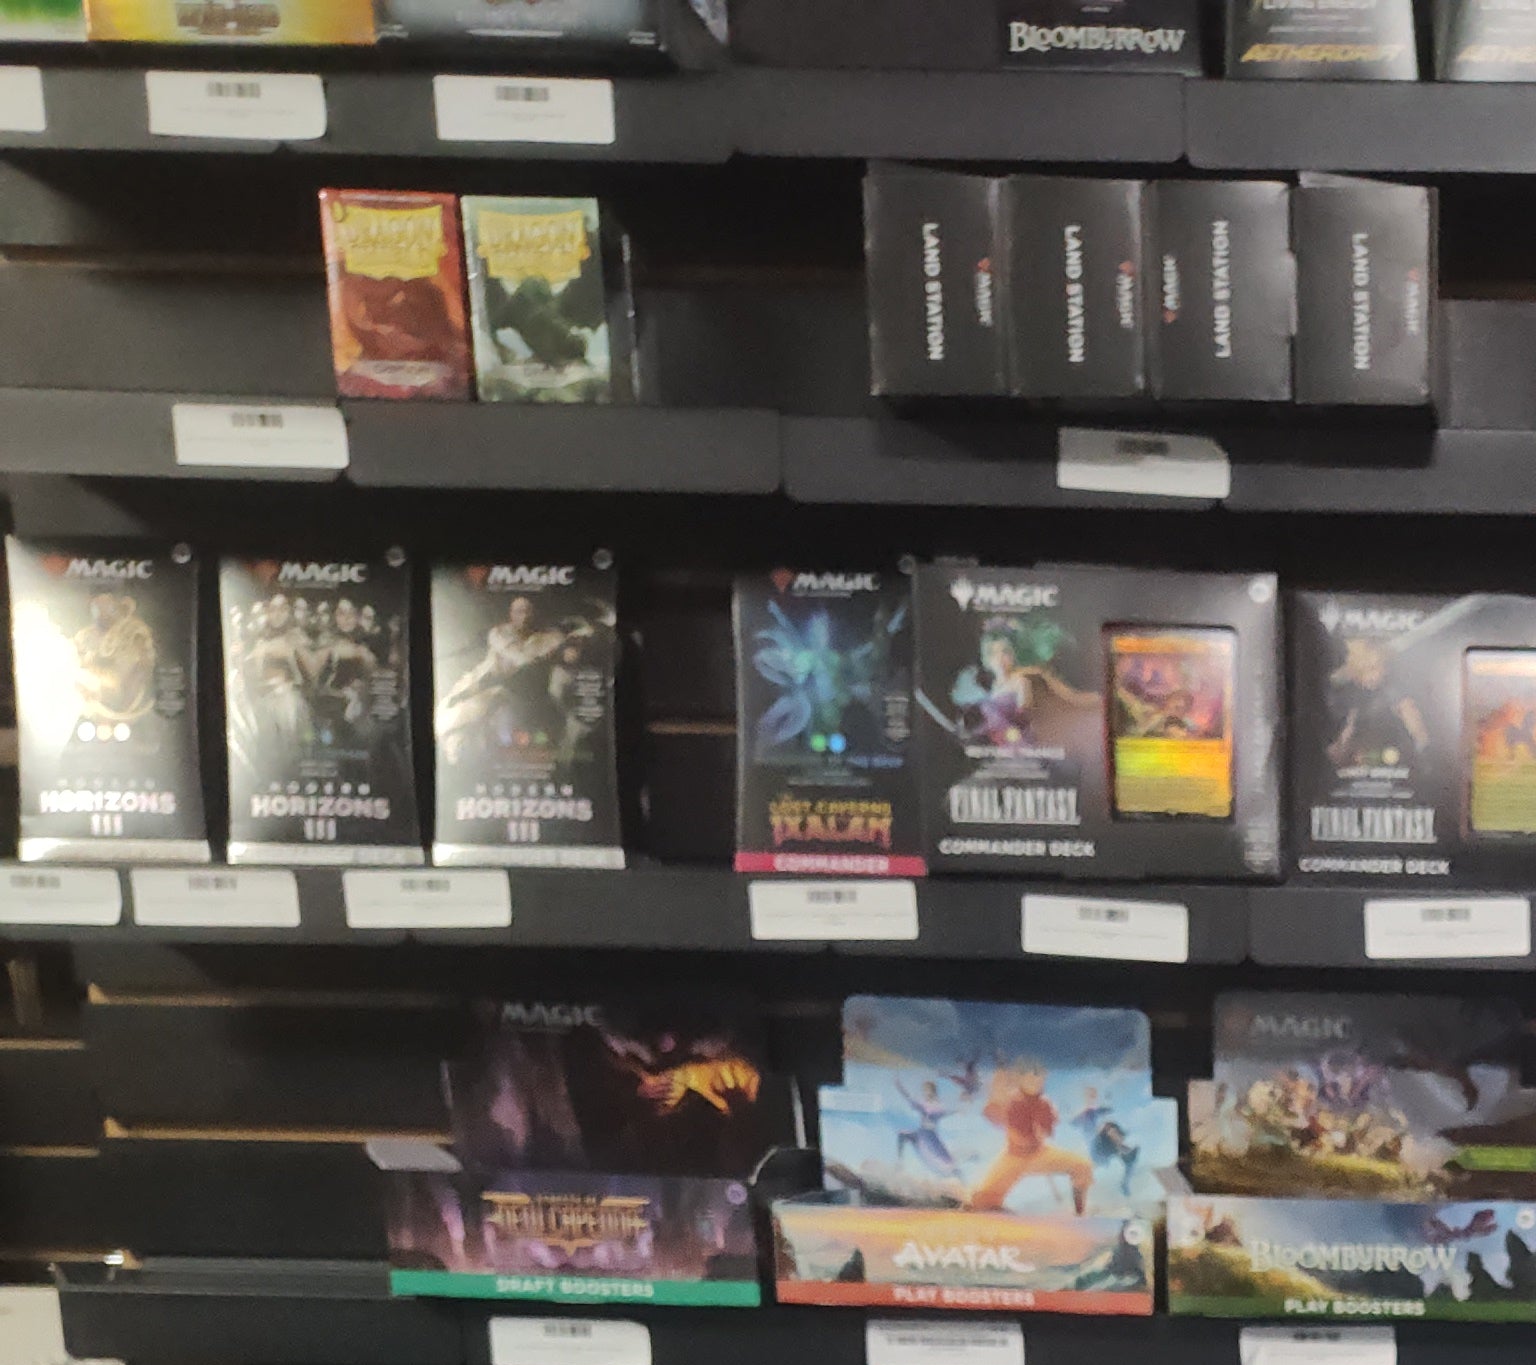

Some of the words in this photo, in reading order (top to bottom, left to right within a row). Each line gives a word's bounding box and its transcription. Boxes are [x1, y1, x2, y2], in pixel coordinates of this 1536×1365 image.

[923, 222, 940, 278] LAND
[1064, 225, 1082, 278] LAND
[1211, 220, 1229, 300] STATION
[1352, 234, 1368, 287] LAND
[925, 281, 944, 362] STATION
[1066, 282, 1084, 364] STATION
[1213, 305, 1232, 359] LAND
[1353, 291, 1370, 370] STATION
[64, 558, 153, 581] MAGIC
[278, 561, 367, 585] MAGIC
[488, 565, 575, 587] MAGIC
[974, 584, 1059, 607] MAGIC
[40, 789, 176, 816] HORIZONS
[250, 793, 391, 820] HORIZONS
[455, 797, 594, 822] HORIZONS
[1298, 857, 1403, 875] COMMANDER
[1406, 858, 1450, 876] DECK
[892, 1240, 1036, 1273] AVATAR
[496, 1278, 554, 1293] DRAFT
[559, 1280, 654, 1297] BOOSTERS
[1284, 1298, 1329, 1314] PLAY
[1332, 1299, 1426, 1316] BOOSTERS
